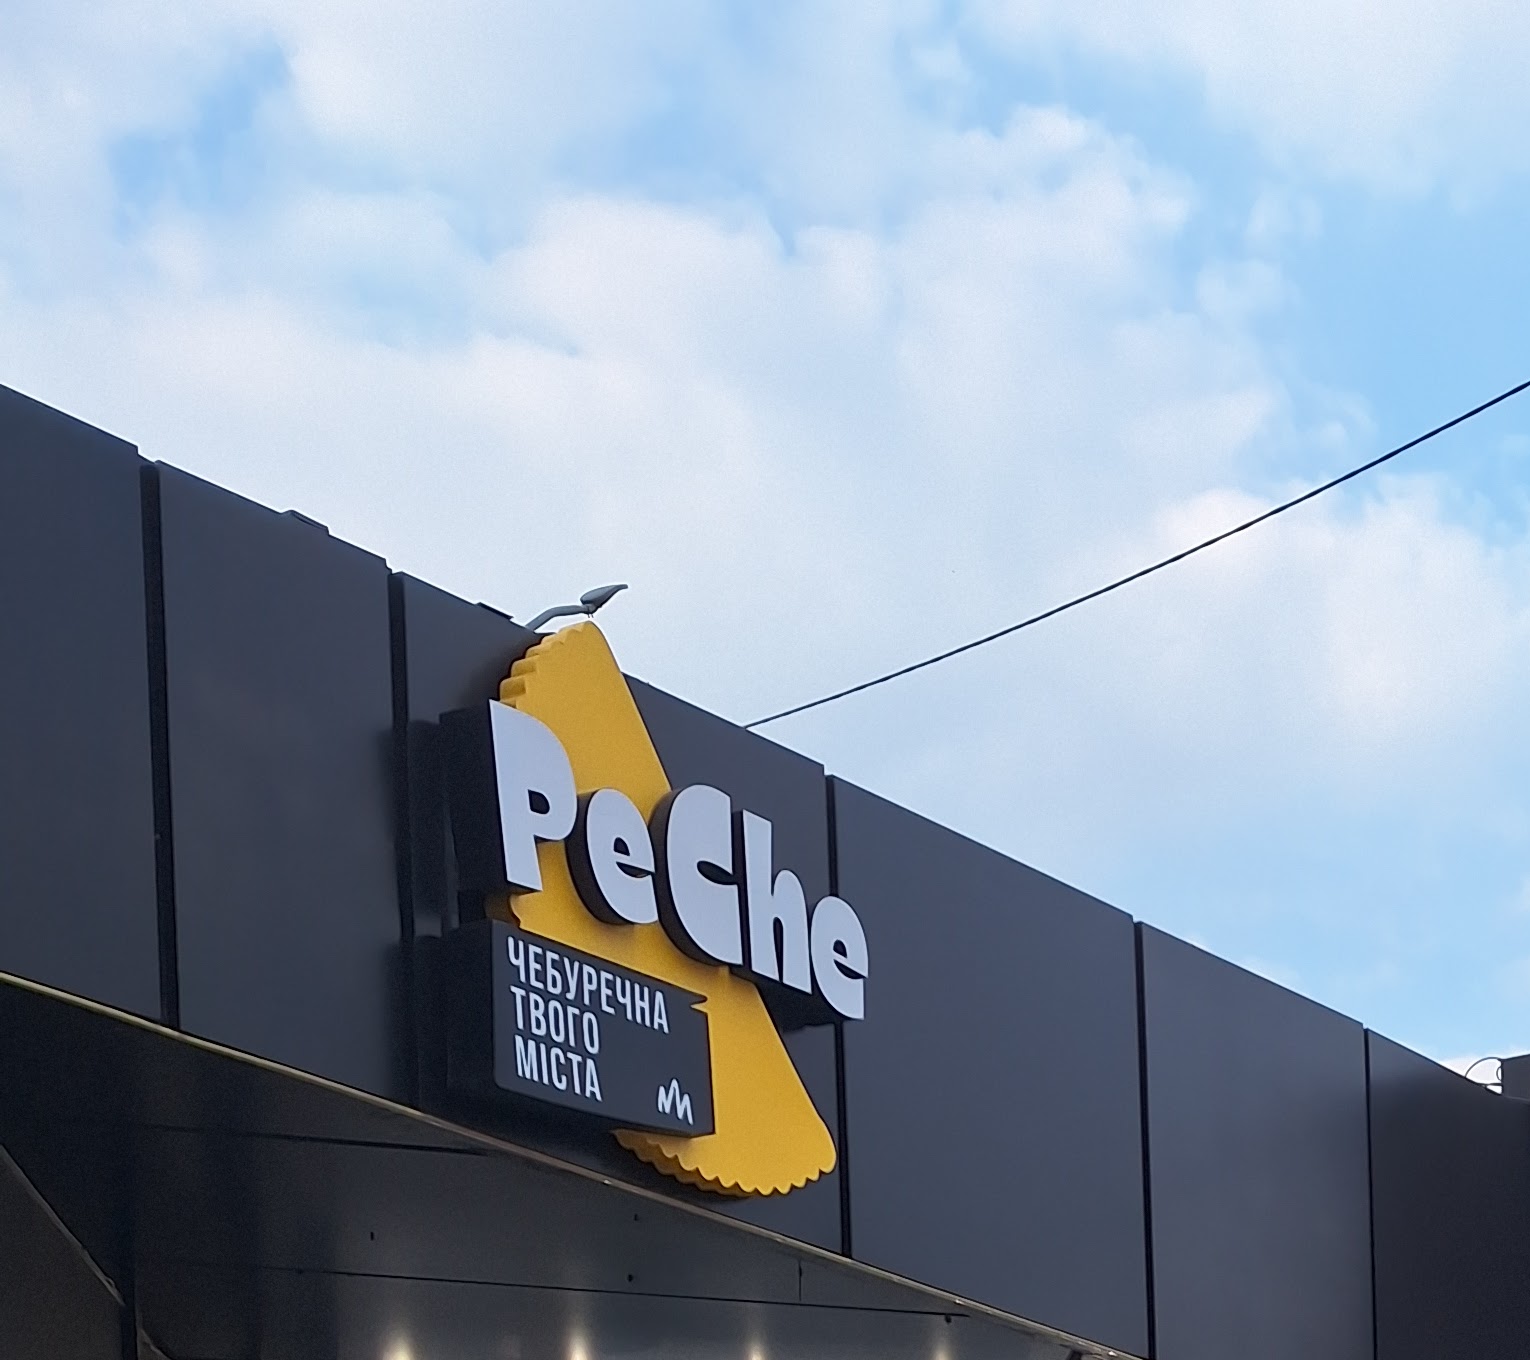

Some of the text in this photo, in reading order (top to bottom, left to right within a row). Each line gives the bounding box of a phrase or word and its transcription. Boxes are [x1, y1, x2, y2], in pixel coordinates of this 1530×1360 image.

[489, 698, 869, 1020] PeChe
[507, 936, 669, 1034] ЧЕБУРЕЧНА
[510, 986, 600, 1055] ТВОГО
[514, 1035, 602, 1101] МІСТА
